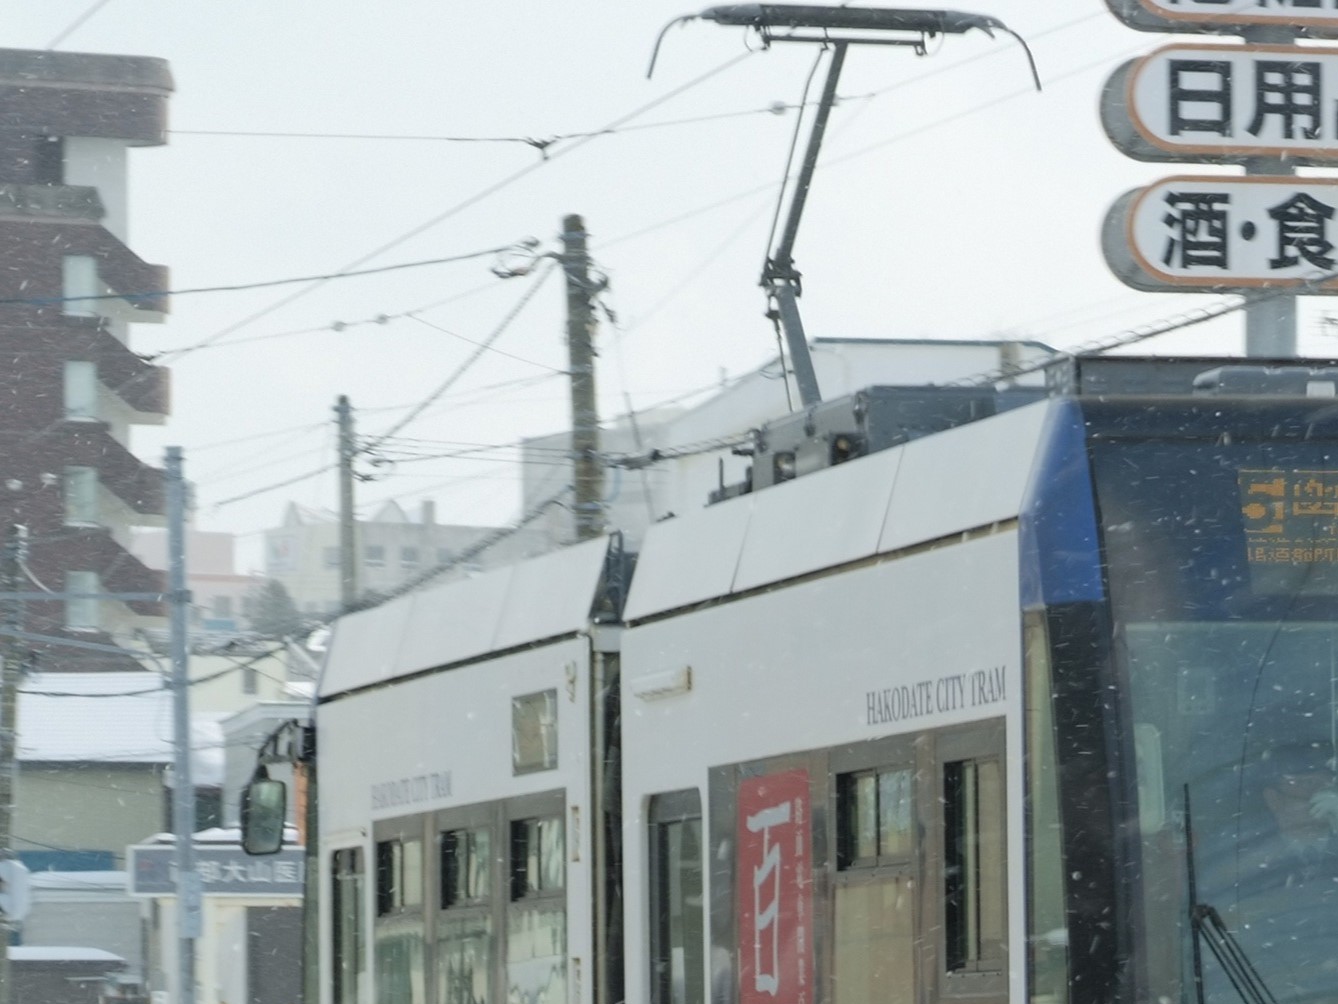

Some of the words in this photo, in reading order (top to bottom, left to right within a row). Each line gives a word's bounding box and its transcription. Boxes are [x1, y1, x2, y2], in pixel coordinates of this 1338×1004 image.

[866, 680, 934, 725] HAKODATE
[936, 674, 966, 713] CITY
[967, 665, 1006, 706] TRAM
